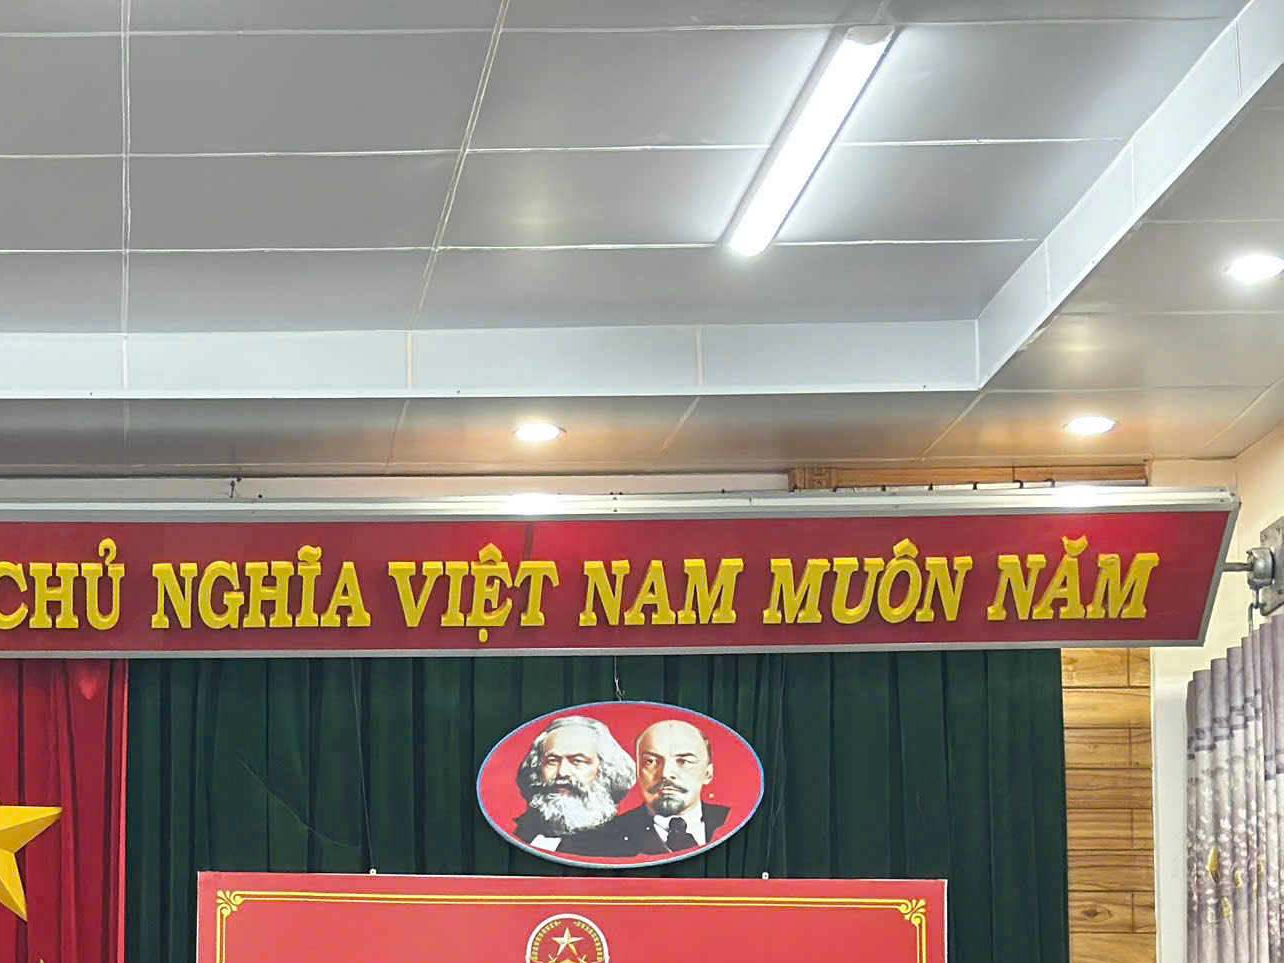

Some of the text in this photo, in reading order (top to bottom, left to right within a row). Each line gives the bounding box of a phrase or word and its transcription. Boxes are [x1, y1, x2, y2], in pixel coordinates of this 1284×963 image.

[151, 544, 372, 629] NGHĨA
[387, 542, 560, 643] VIỆT
[579, 557, 744, 626] NAM
[762, 538, 974, 624] MUÔN
[987, 535, 1160, 621] NĂM
